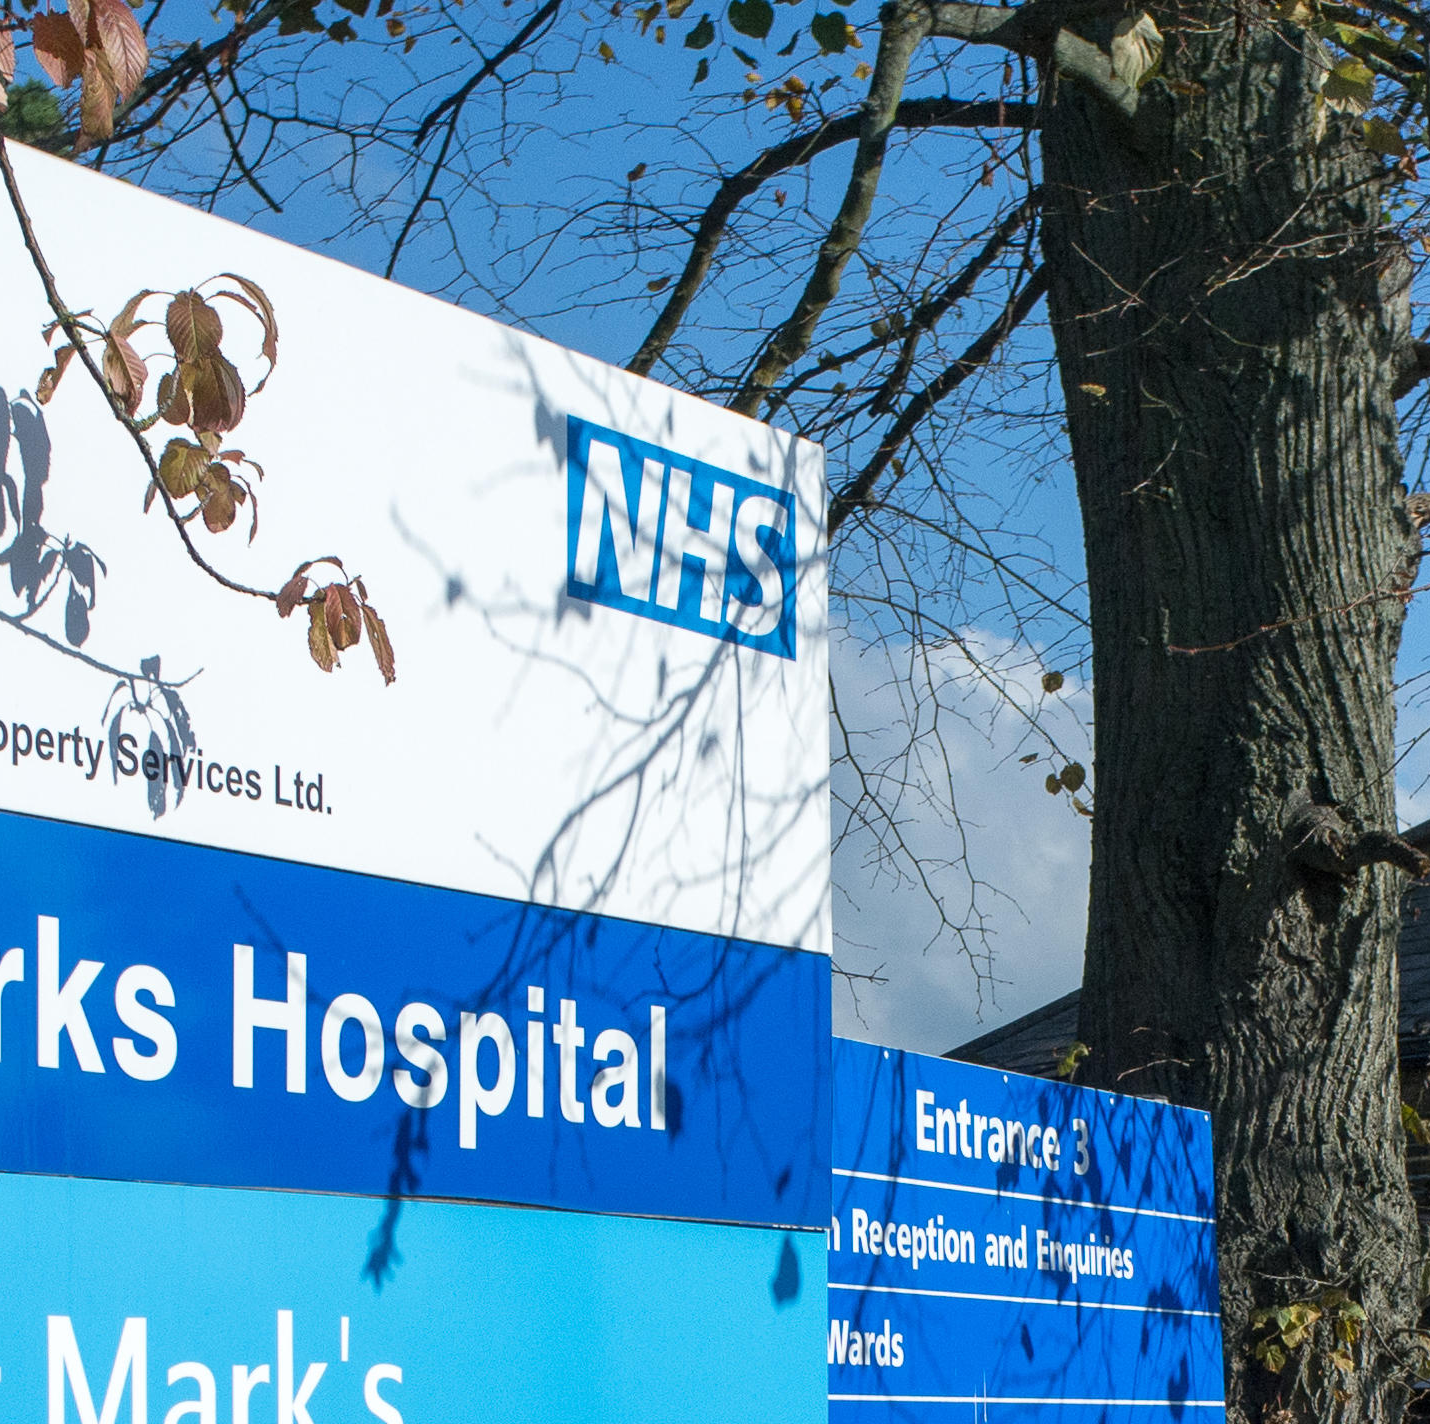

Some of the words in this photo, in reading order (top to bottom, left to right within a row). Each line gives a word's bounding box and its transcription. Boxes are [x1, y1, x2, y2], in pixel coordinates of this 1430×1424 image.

[574, 439, 788, 636] NHS
[117, 733, 262, 800] Services
[275, 765, 333, 815] Ltd.
[231, 943, 667, 1149] Hospital
[915, 1088, 1061, 1172] Entrance
[1073, 1117, 1090, 1176] 3
[852, 1208, 975, 1270] Reception
[985, 1224, 1028, 1269] and
[1036, 1229, 1134, 1284] Enquiries
[827, 1318, 905, 1368] Wards
